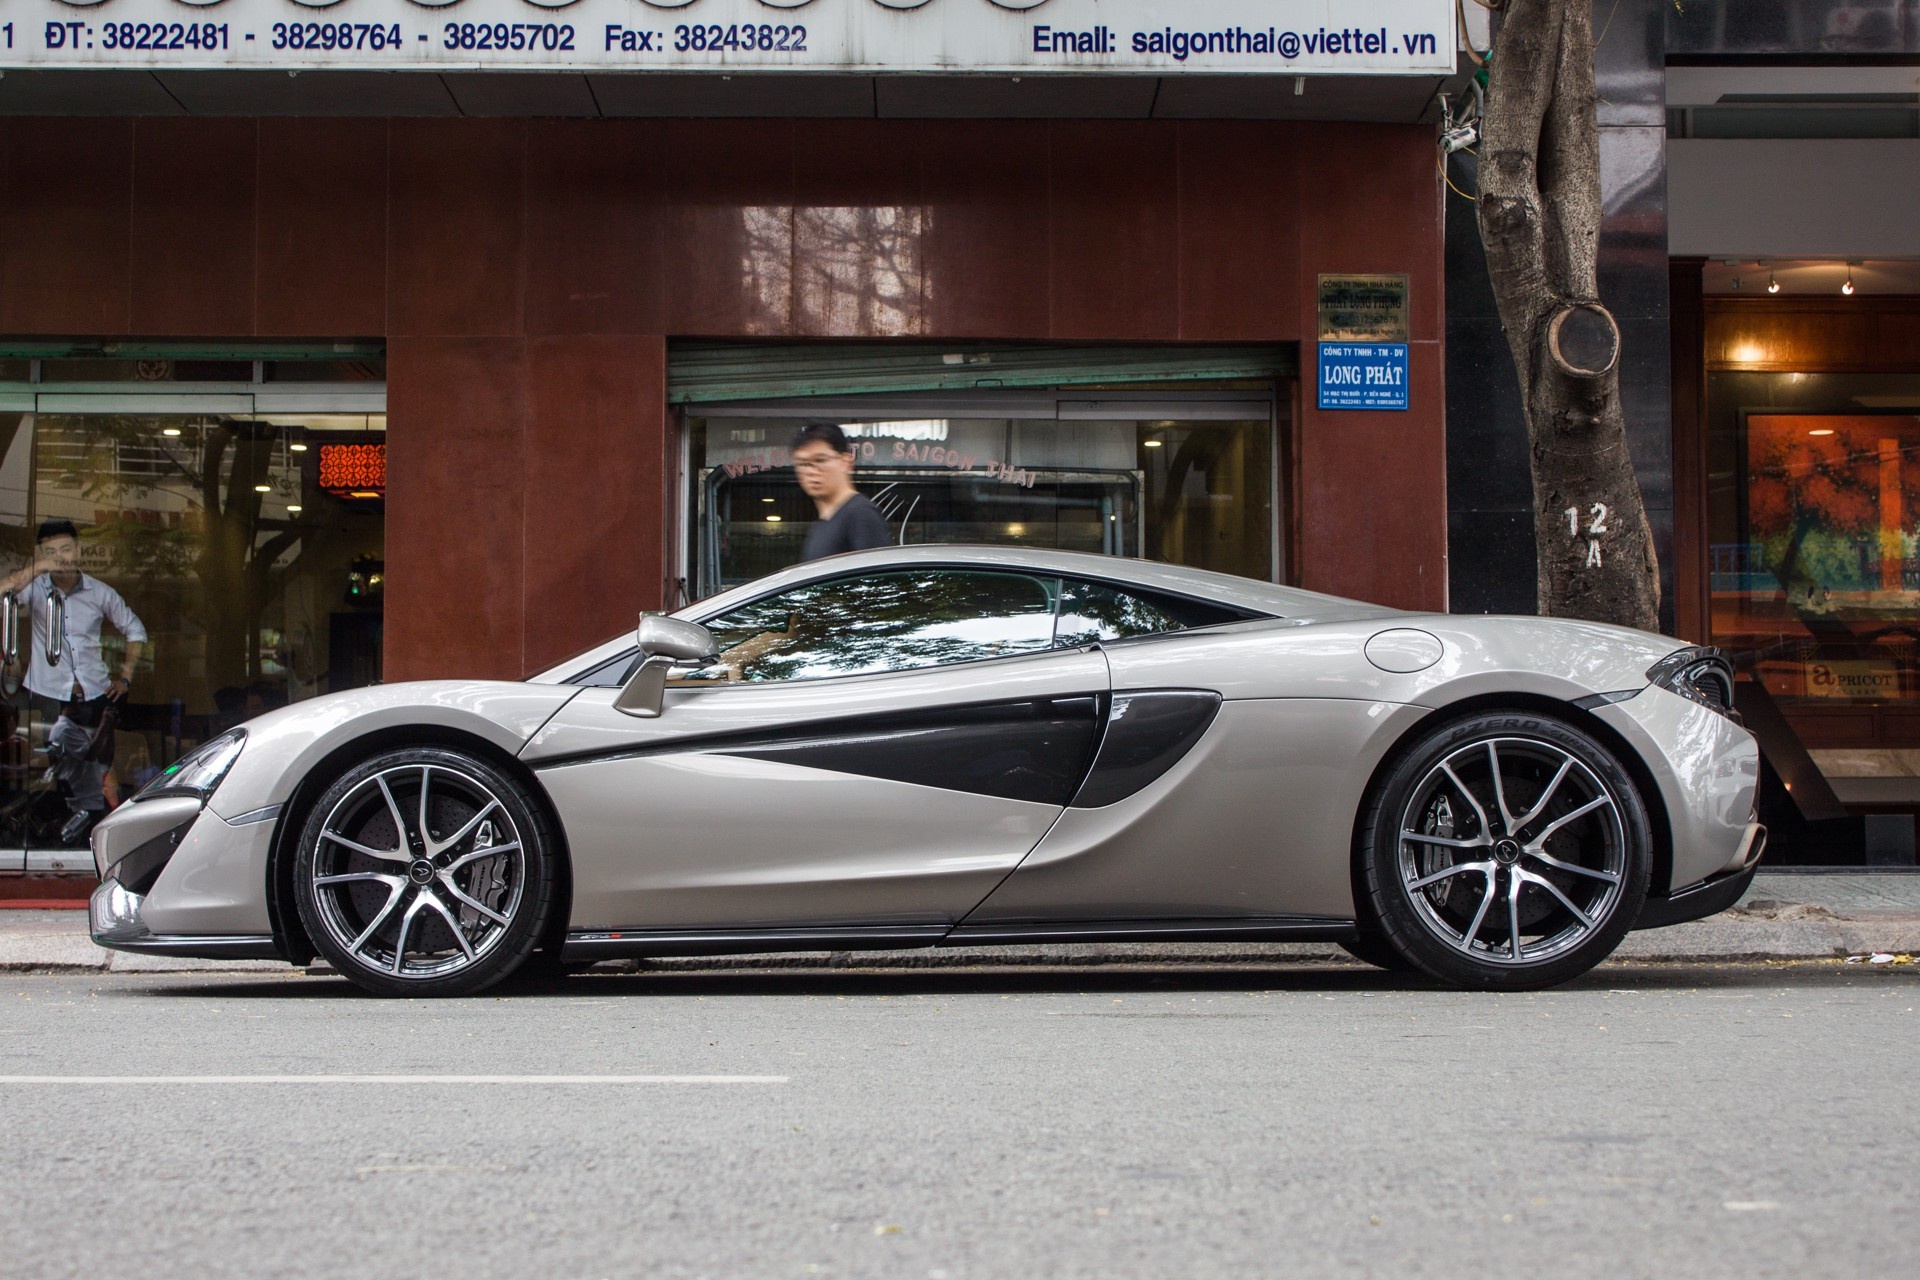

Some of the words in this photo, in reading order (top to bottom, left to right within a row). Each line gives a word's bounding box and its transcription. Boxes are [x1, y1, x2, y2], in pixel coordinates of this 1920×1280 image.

[3, 22, 13, 48] 1
[45, 22, 92, 48] ĐT:
[102, 22, 228, 49] 38222481
[272, 23, 402, 49] 38298764
[444, 23, 574, 50] 38295702
[606, 25, 662, 51] Fax:
[674, 24, 806, 51] 38243822
[1034, 25, 1115, 52] Email:
[1132, 27, 1435, 59] saigonthai@viettel.vn
[1324, 346, 1342, 356] CÔNG
[1344, 348, 1352, 356] TY
[1354, 348, 1372, 356] TNHH
[1378, 348, 1388, 356] TM
[1394, 349, 1404, 357] DV
[1324, 366, 1361, 384] LONG
[1366, 362, 1402, 385] PHÁT
[849, 442, 875, 462] TO
[892, 442, 978, 471] SAIGON
[985, 460, 1036, 488] THAI
[1564, 502, 1607, 537] 12
